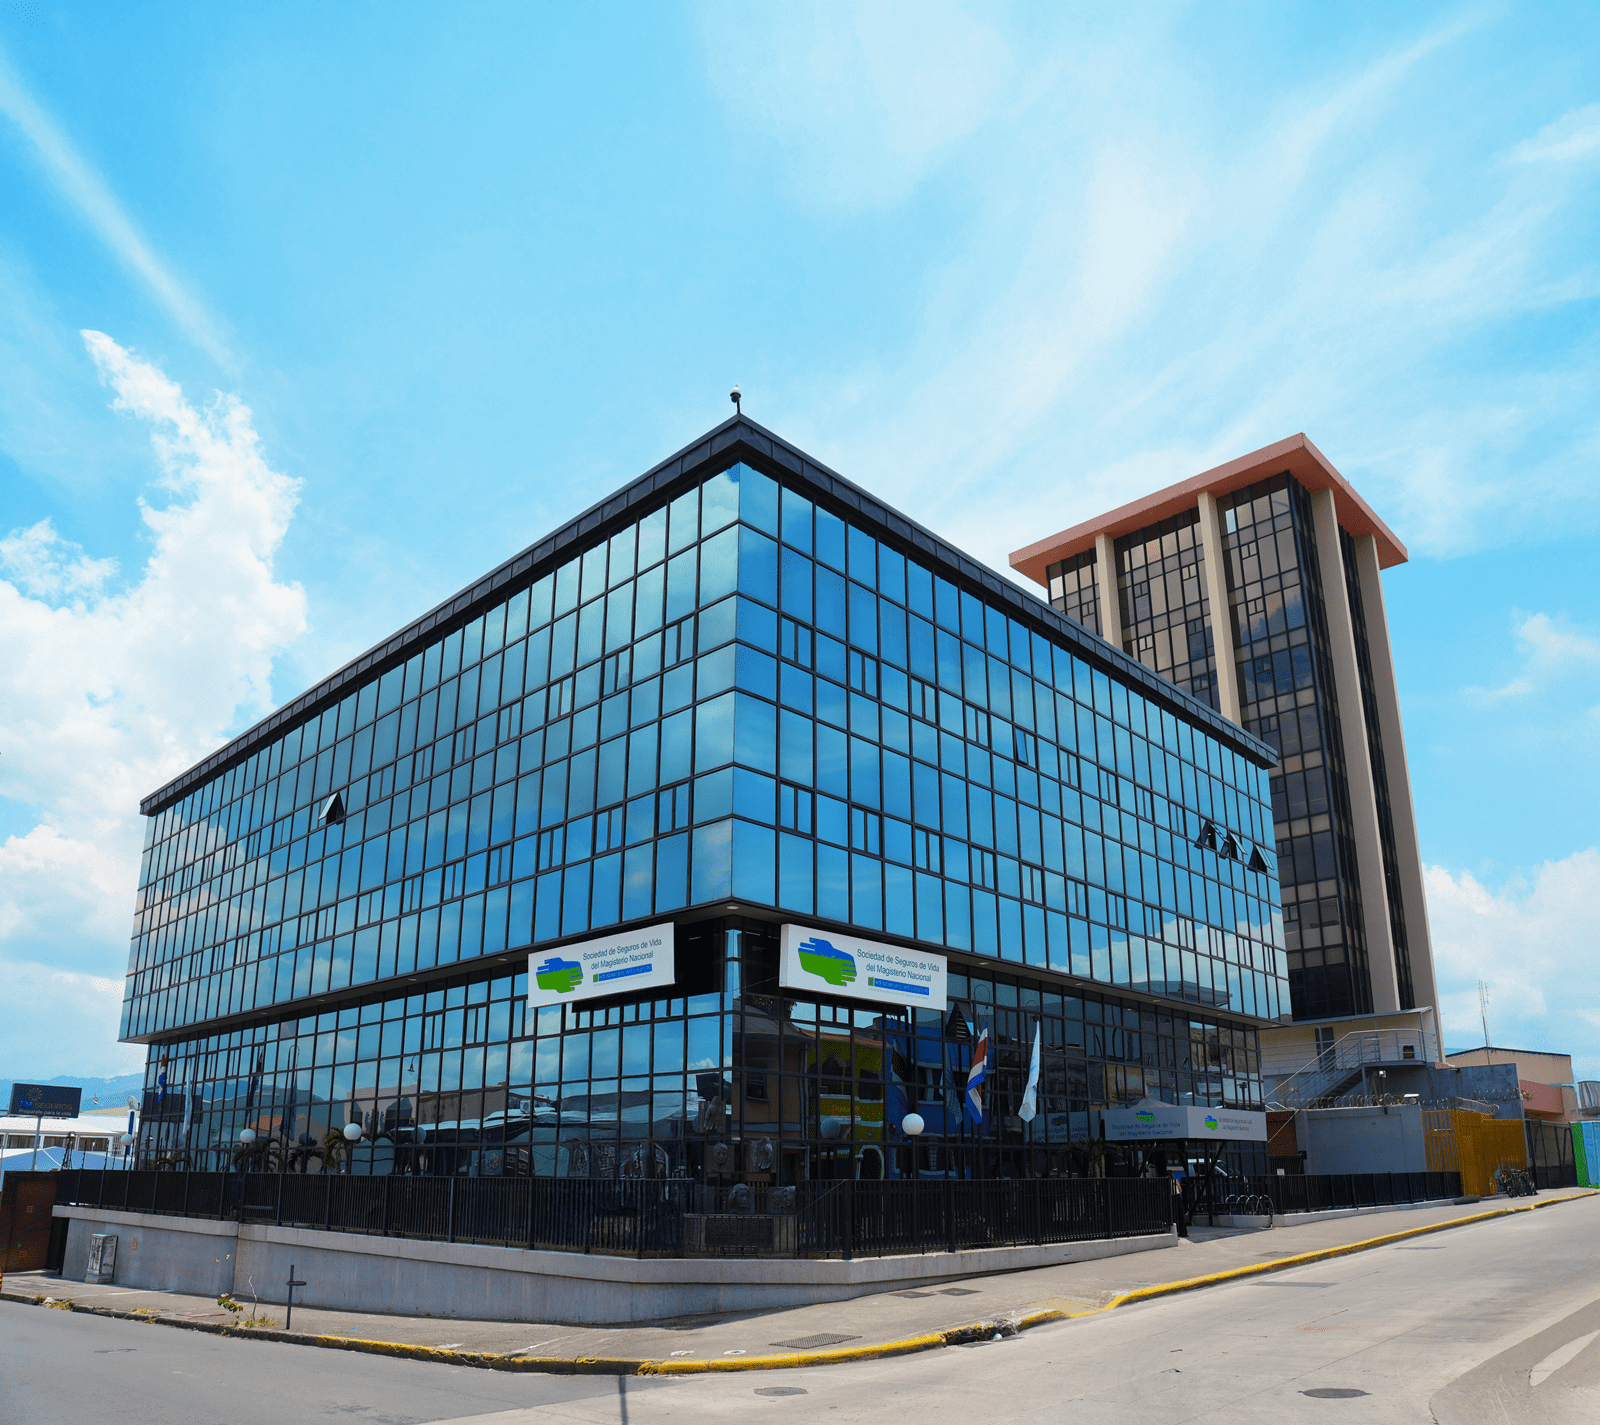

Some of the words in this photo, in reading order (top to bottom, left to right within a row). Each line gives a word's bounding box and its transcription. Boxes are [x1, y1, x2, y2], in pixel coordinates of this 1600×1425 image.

[582, 948, 608, 960] Sociedad
[608, 948, 616, 956] de
[616, 943, 640, 954] Seguros
[649, 938, 662, 947] Vida
[591, 961, 600, 970] del
[600, 956, 628, 968] Magisterio
[629, 950, 653, 962] Nacional
[856, 948, 885, 962] Sociedad
[886, 955, 894, 963] de
[894, 956, 918, 968] Seguros
[919, 962, 926, 970] de
[928, 962, 939, 972] Vida
[866, 963, 875, 972] del
[877, 965, 906, 978] Magisterio
[907, 971, 931, 982] Nacional
